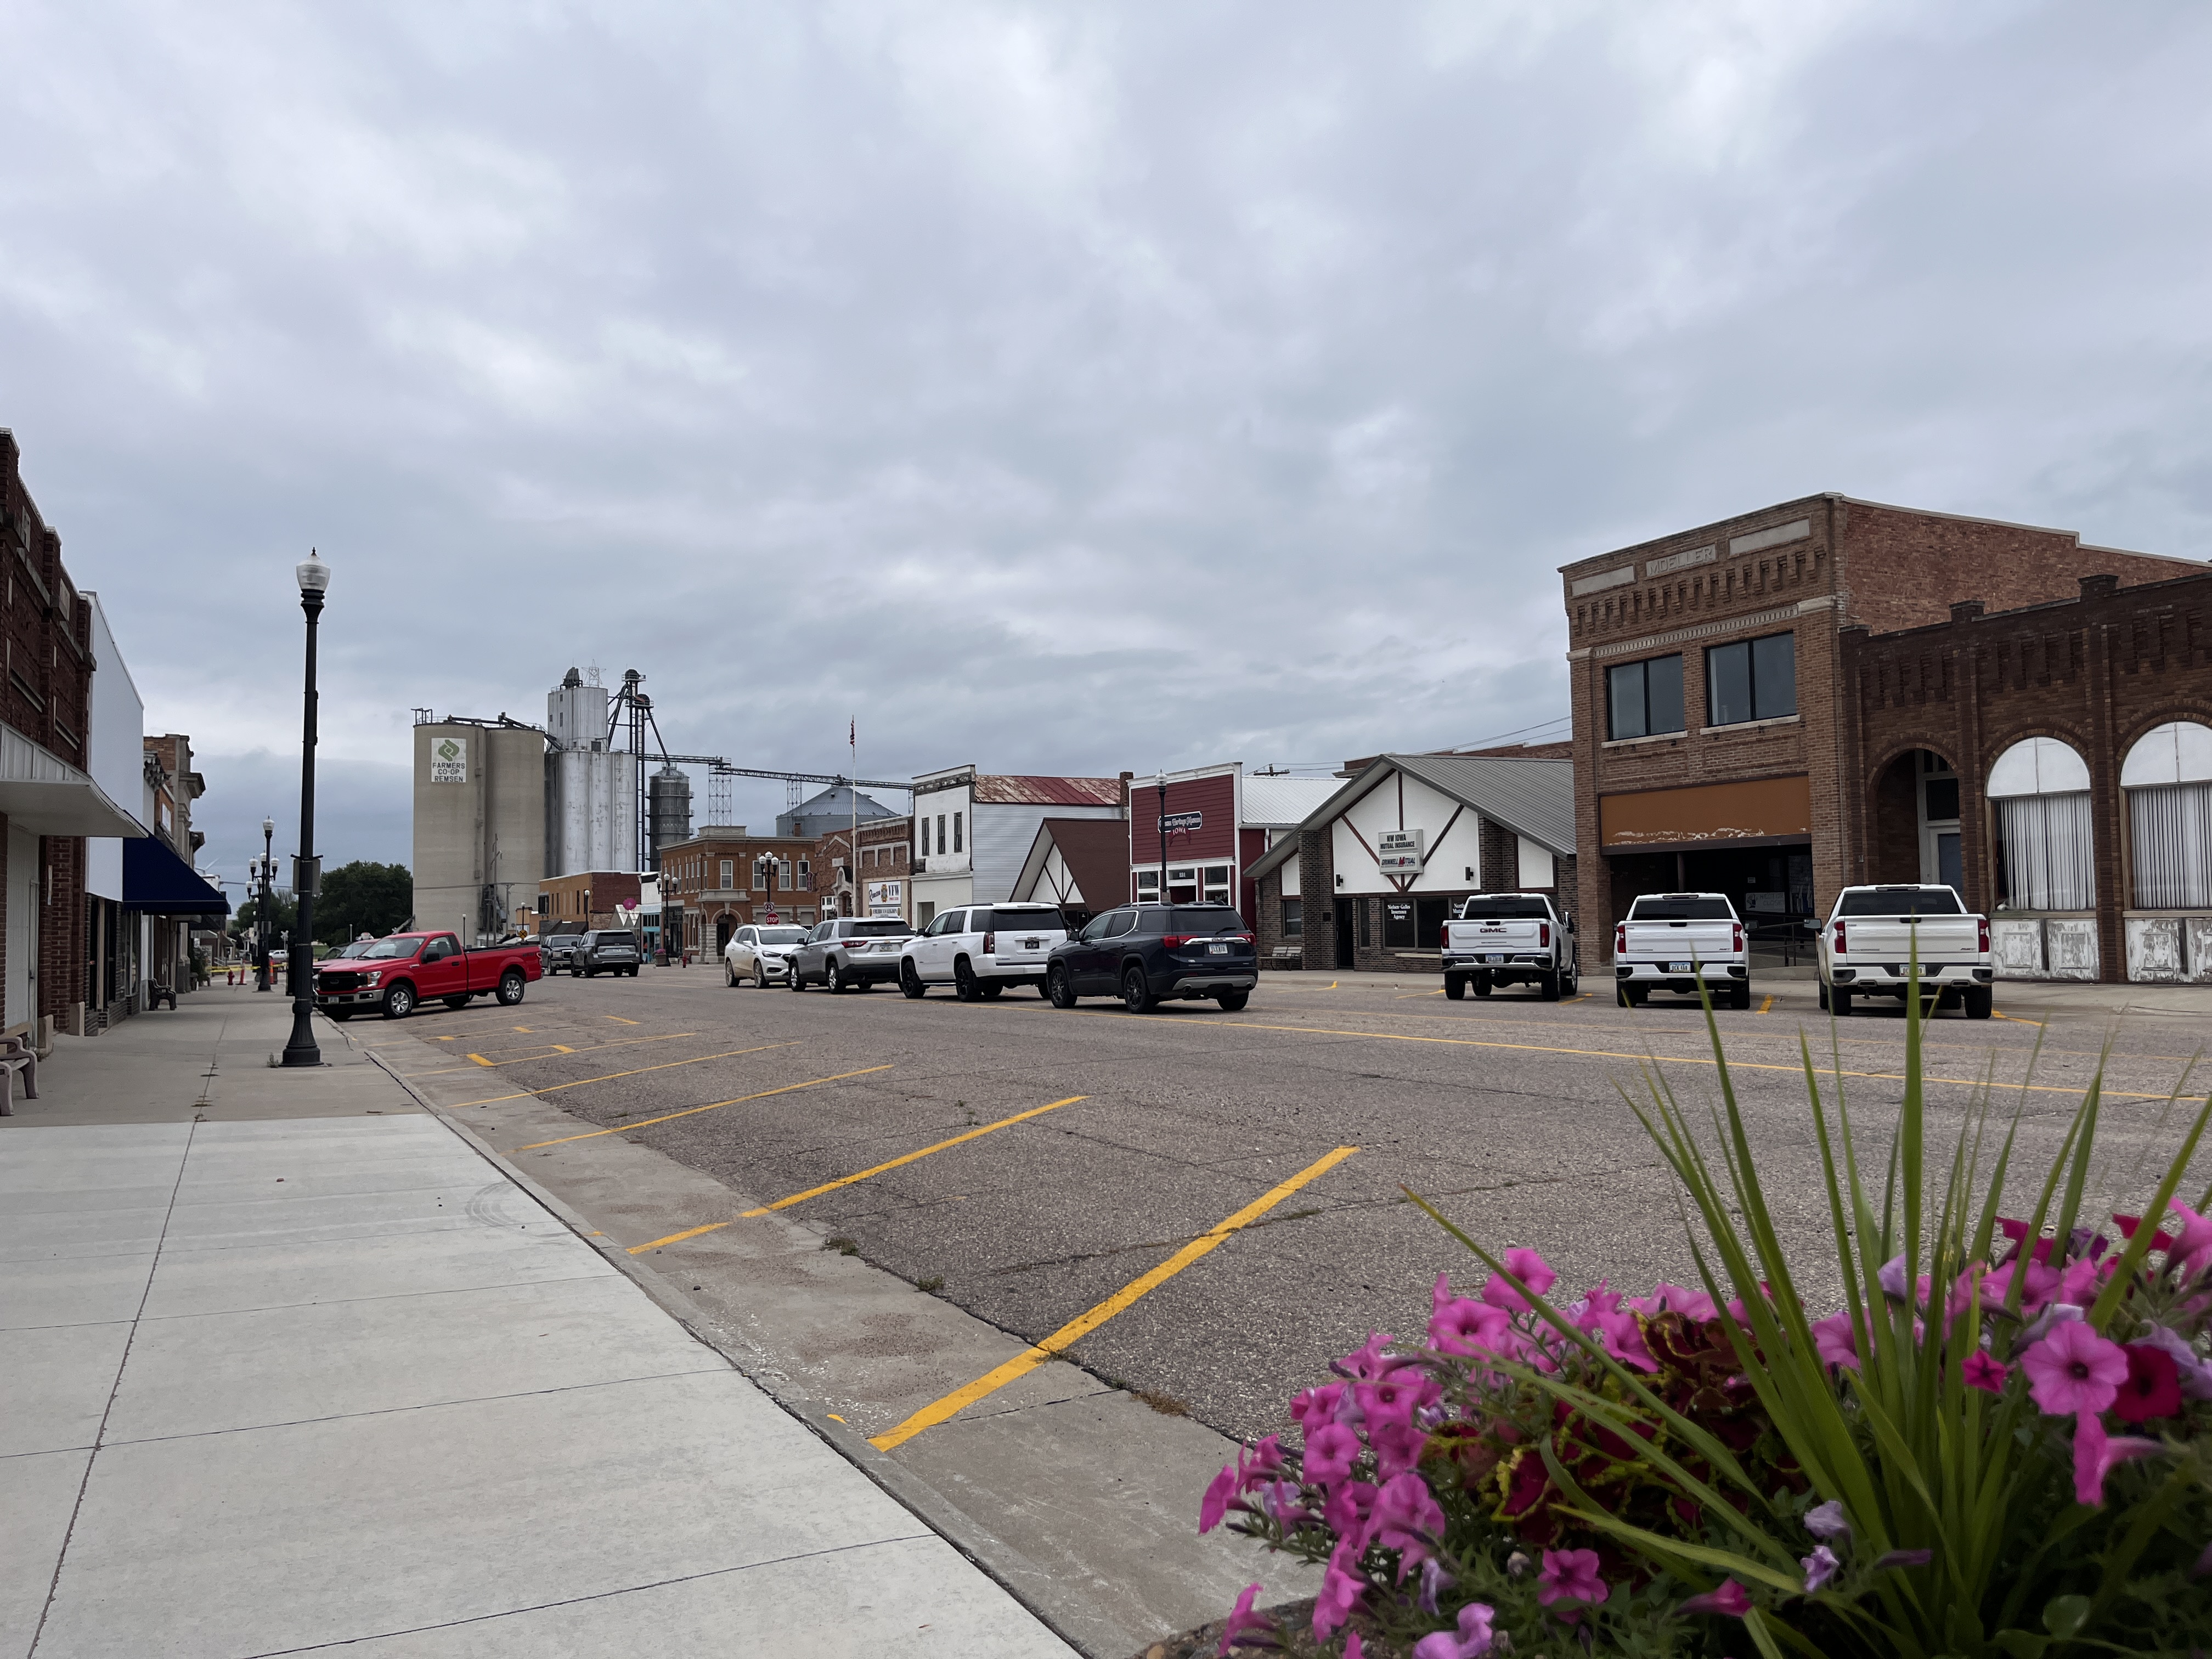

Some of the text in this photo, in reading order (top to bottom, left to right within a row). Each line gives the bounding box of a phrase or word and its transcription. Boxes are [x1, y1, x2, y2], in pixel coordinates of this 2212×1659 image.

[1650, 548, 1712, 574] MOELLER
[1172, 827, 1186, 835] IOWA
[889, 885, 900, 896] VFW
